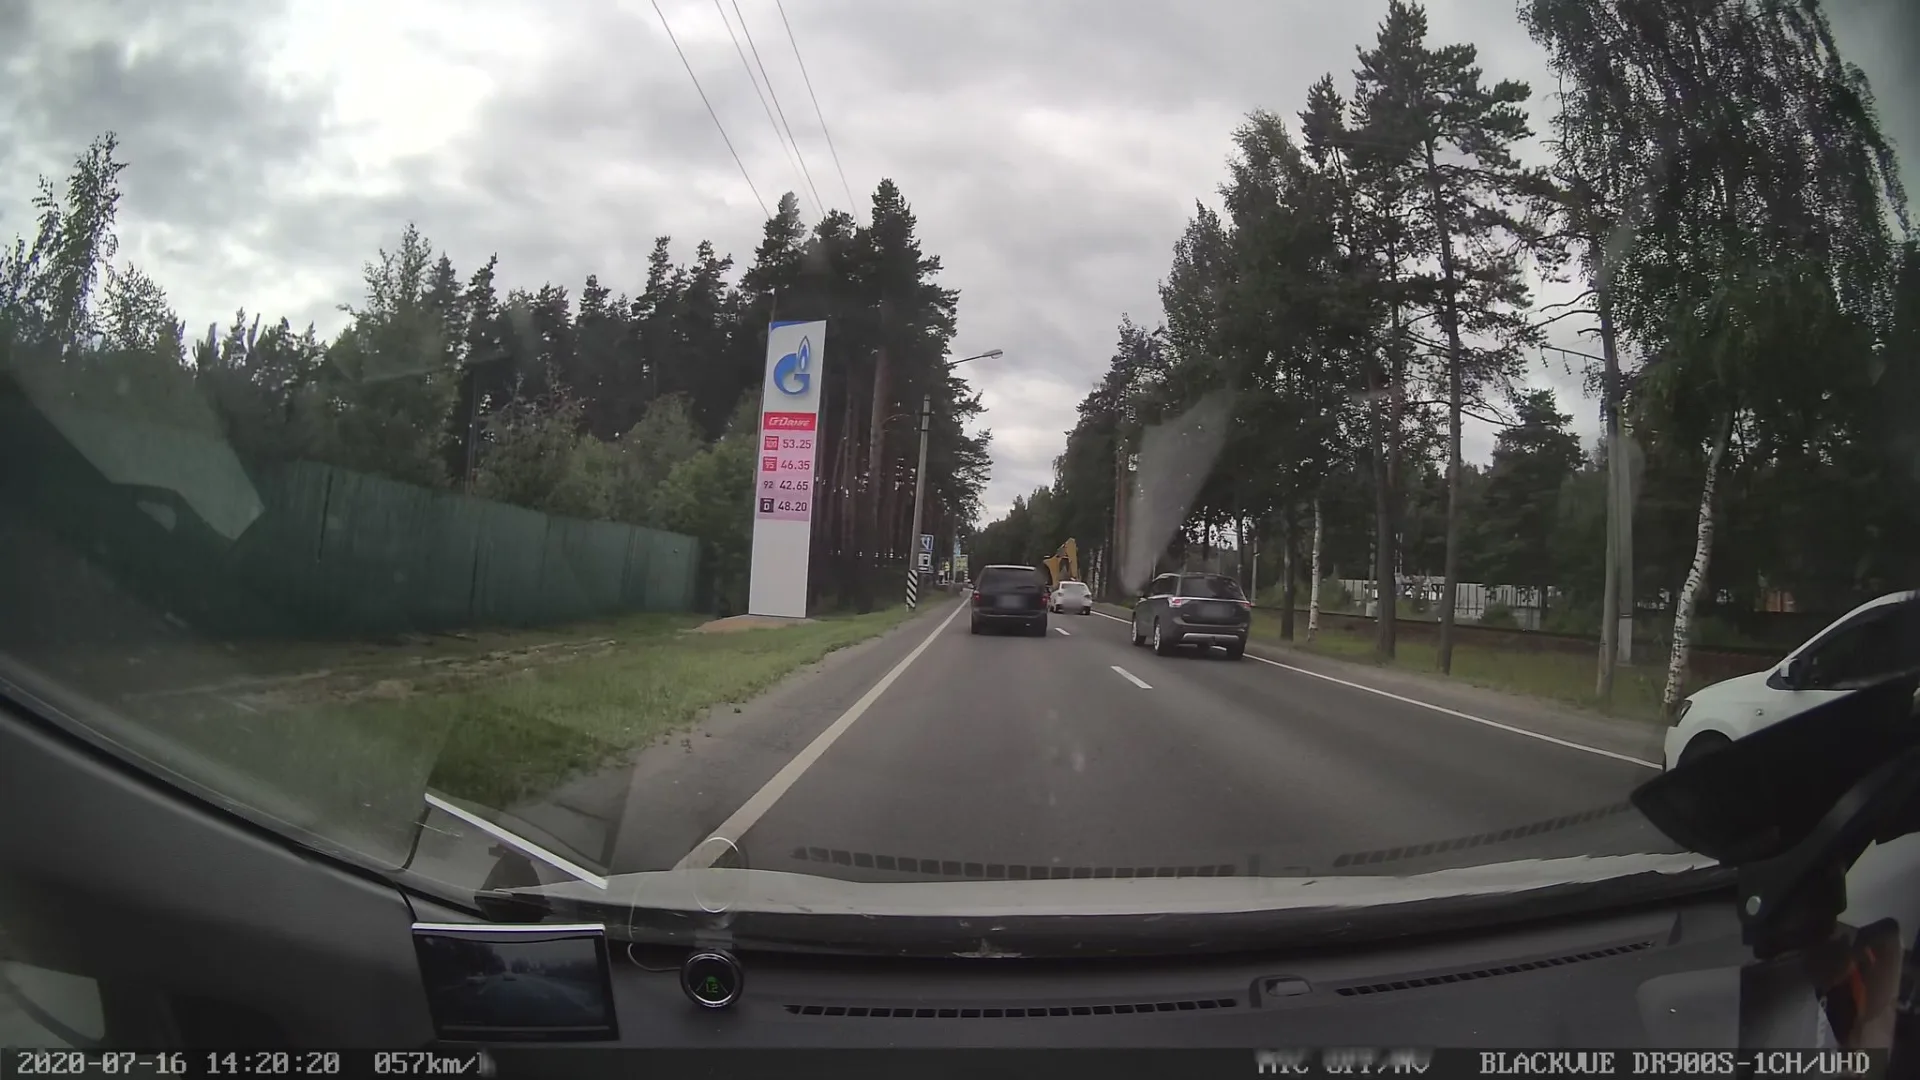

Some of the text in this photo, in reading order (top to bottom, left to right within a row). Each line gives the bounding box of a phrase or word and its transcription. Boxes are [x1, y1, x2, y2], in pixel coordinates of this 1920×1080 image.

[783, 439, 811, 449] 53.25
[781, 460, 810, 470] 46.35
[763, 480, 809, 490] 92 42.65
[778, 501, 807, 511] 48.20
